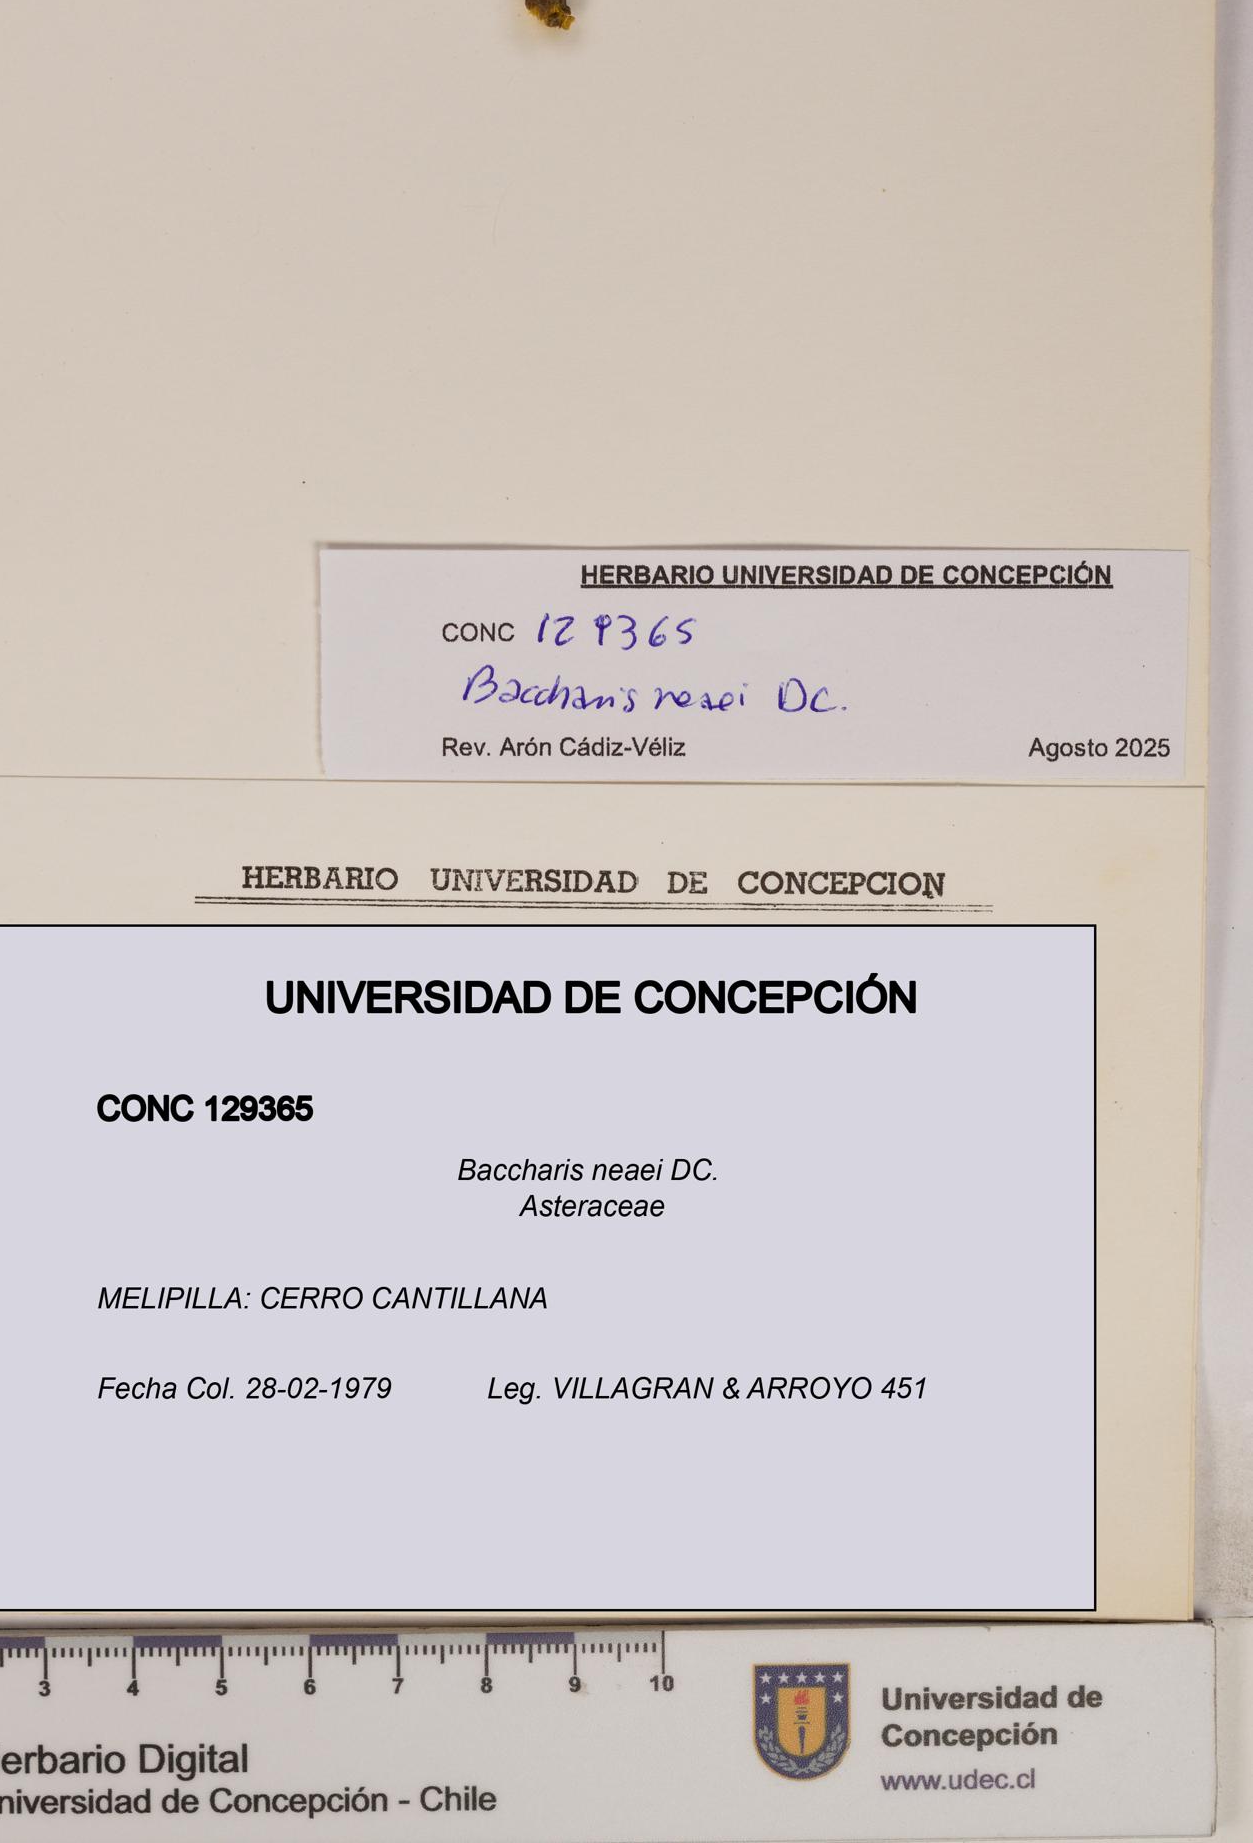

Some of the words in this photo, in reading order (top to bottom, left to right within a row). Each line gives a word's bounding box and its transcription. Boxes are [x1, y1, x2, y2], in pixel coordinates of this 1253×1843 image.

[581, 564, 715, 585] HERBARIO
[722, 564, 893, 585] UNIVERSIDAD
[900, 564, 934, 585] DE
[942, 560, 1111, 585] CONCEPCIÓN
[442, 622, 515, 643] CONC
[777, 677, 847, 713] DC.
[442, 736, 491, 757] Rev.
[499, 736, 552, 757] Arón
[559, 736, 687, 757] Cádiz-Véliz
[1028, 737, 1109, 763] Agosto
[1114, 737, 1171, 758] 2025
[242, 865, 399, 892] HERBARIO
[429, 867, 640, 894] UNIVERSIDAD
[667, 870, 708, 895] DE
[737, 870, 946, 900] CONCEPCION
[38, 1677, 52, 1698] 3
[126, 1677, 140, 1697] 4
[214, 1676, 228, 1697] 5
[303, 1675, 317, 1696] 6
[391, 1675, 405, 1695] 7
[480, 1676, 494, 1694] 8
[568, 1675, 582, 1693] 9
[649, 1674, 675, 1693] 10
[882, 1684, 1058, 1712] Universidad
[1066, 1684, 1104, 1709] de
[880, 1721, 1058, 1752] Concepción
[138, 1742, 248, 1782] Digital
[879, 1767, 1036, 1791] www.udec.cl
[161, 1787, 200, 1814] de
[209, 1786, 389, 1820] Concepción
[419, 1785, 498, 1813] Chile
